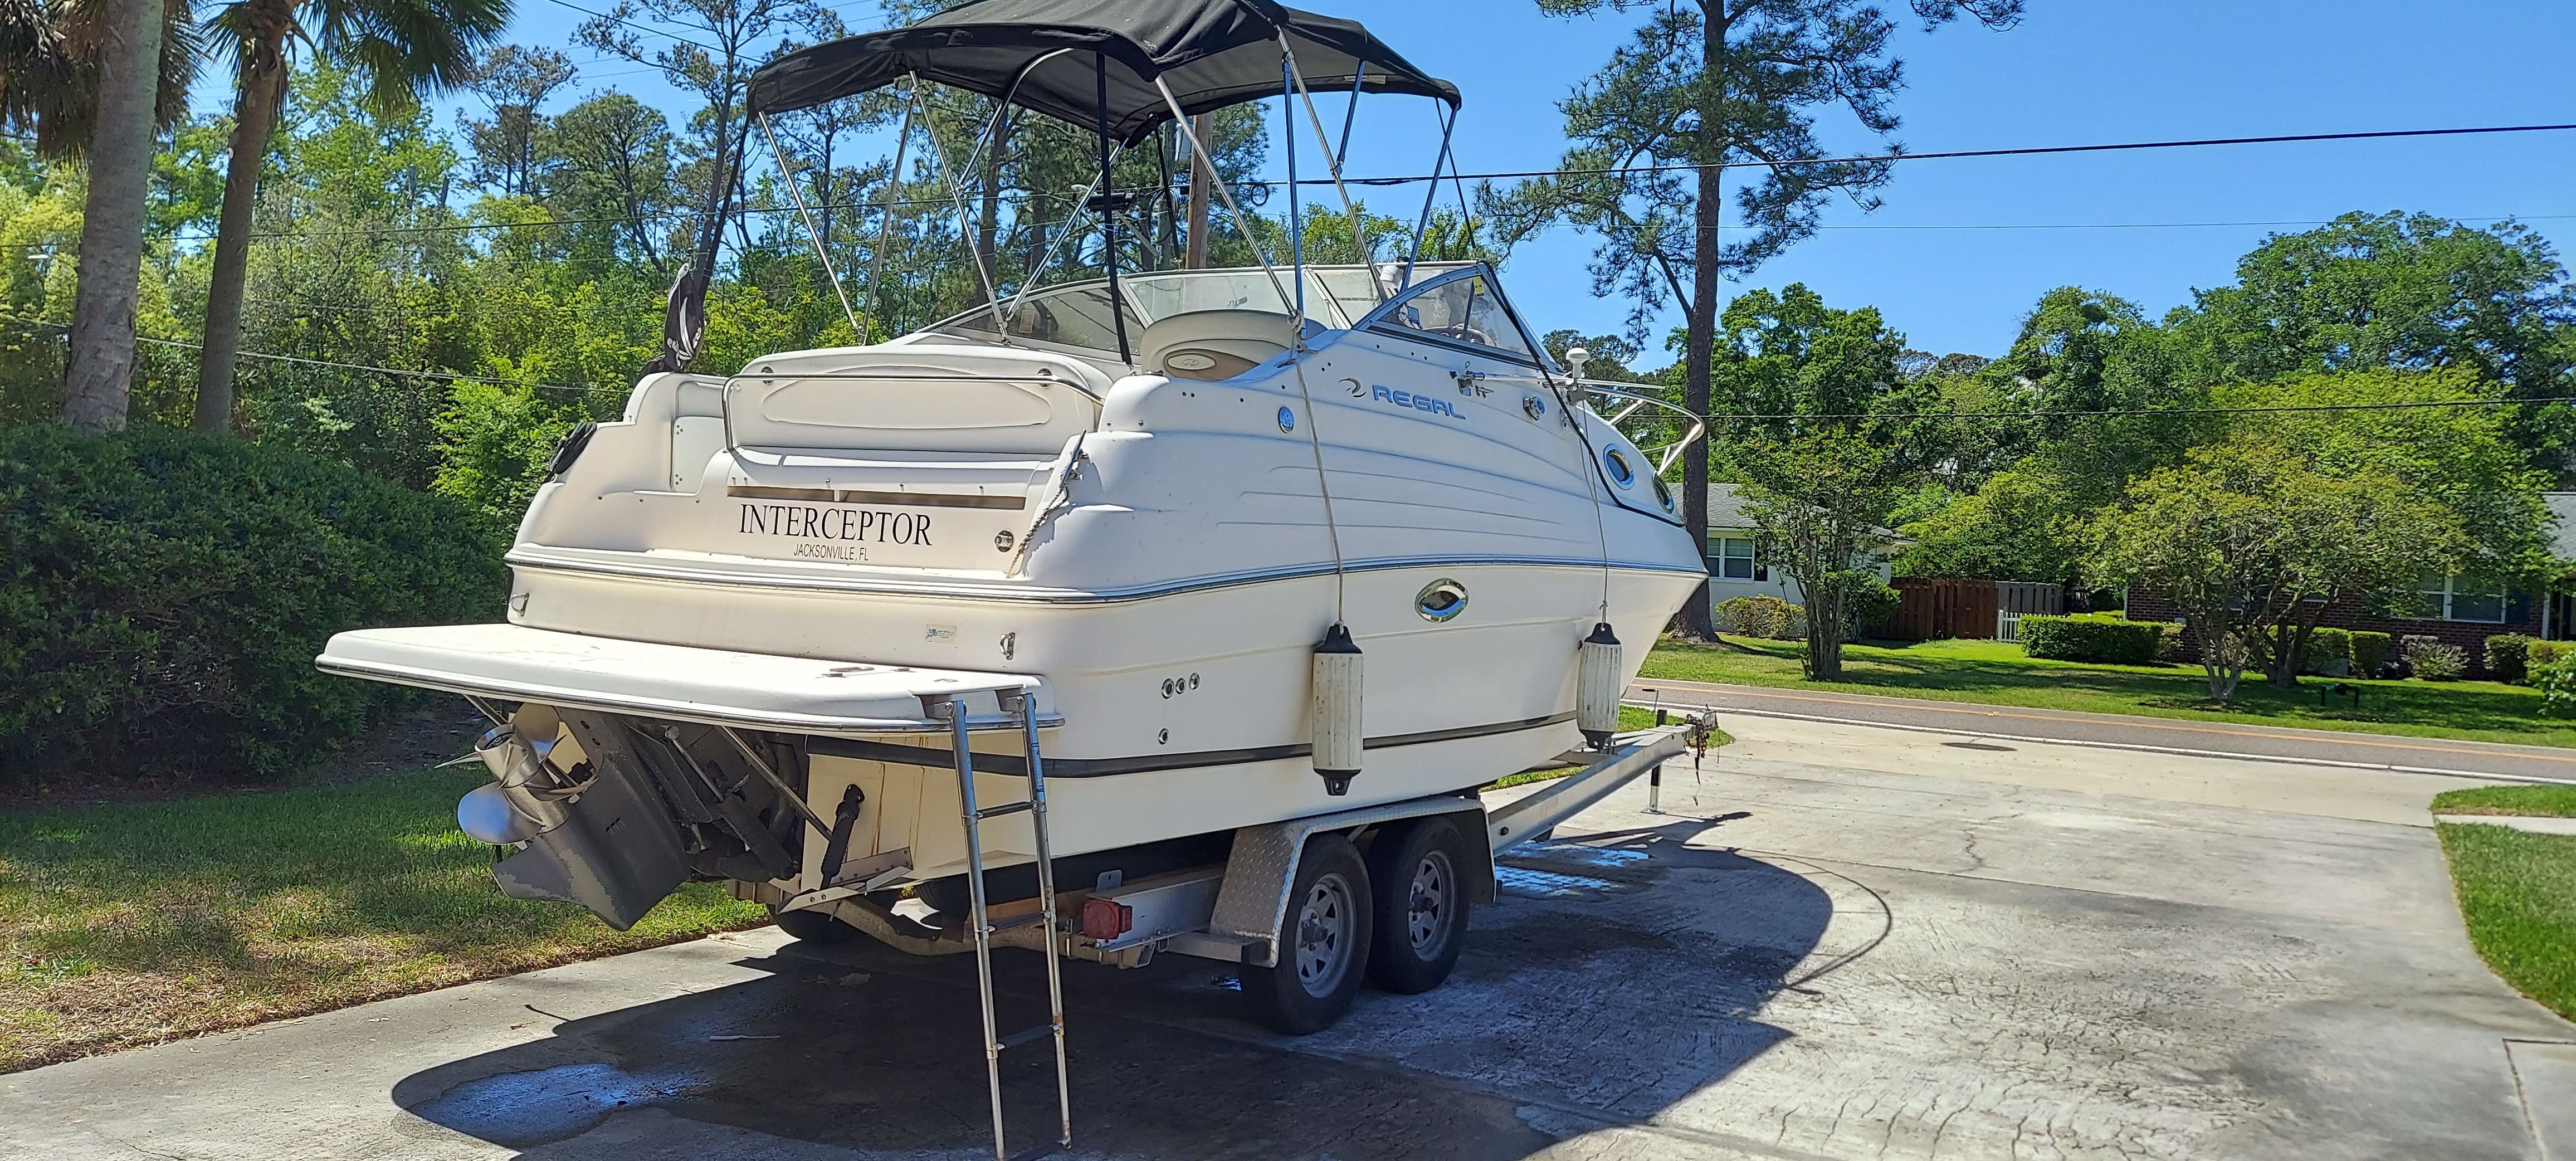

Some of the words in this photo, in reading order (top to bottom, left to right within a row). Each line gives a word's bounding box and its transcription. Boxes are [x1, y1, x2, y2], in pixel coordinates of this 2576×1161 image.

[1372, 384, 1466, 419] REGAL
[738, 504, 933, 546] INTERCEPTOR
[794, 543, 857, 562] JACKSONVILLE,
[859, 547, 869, 561] FL
